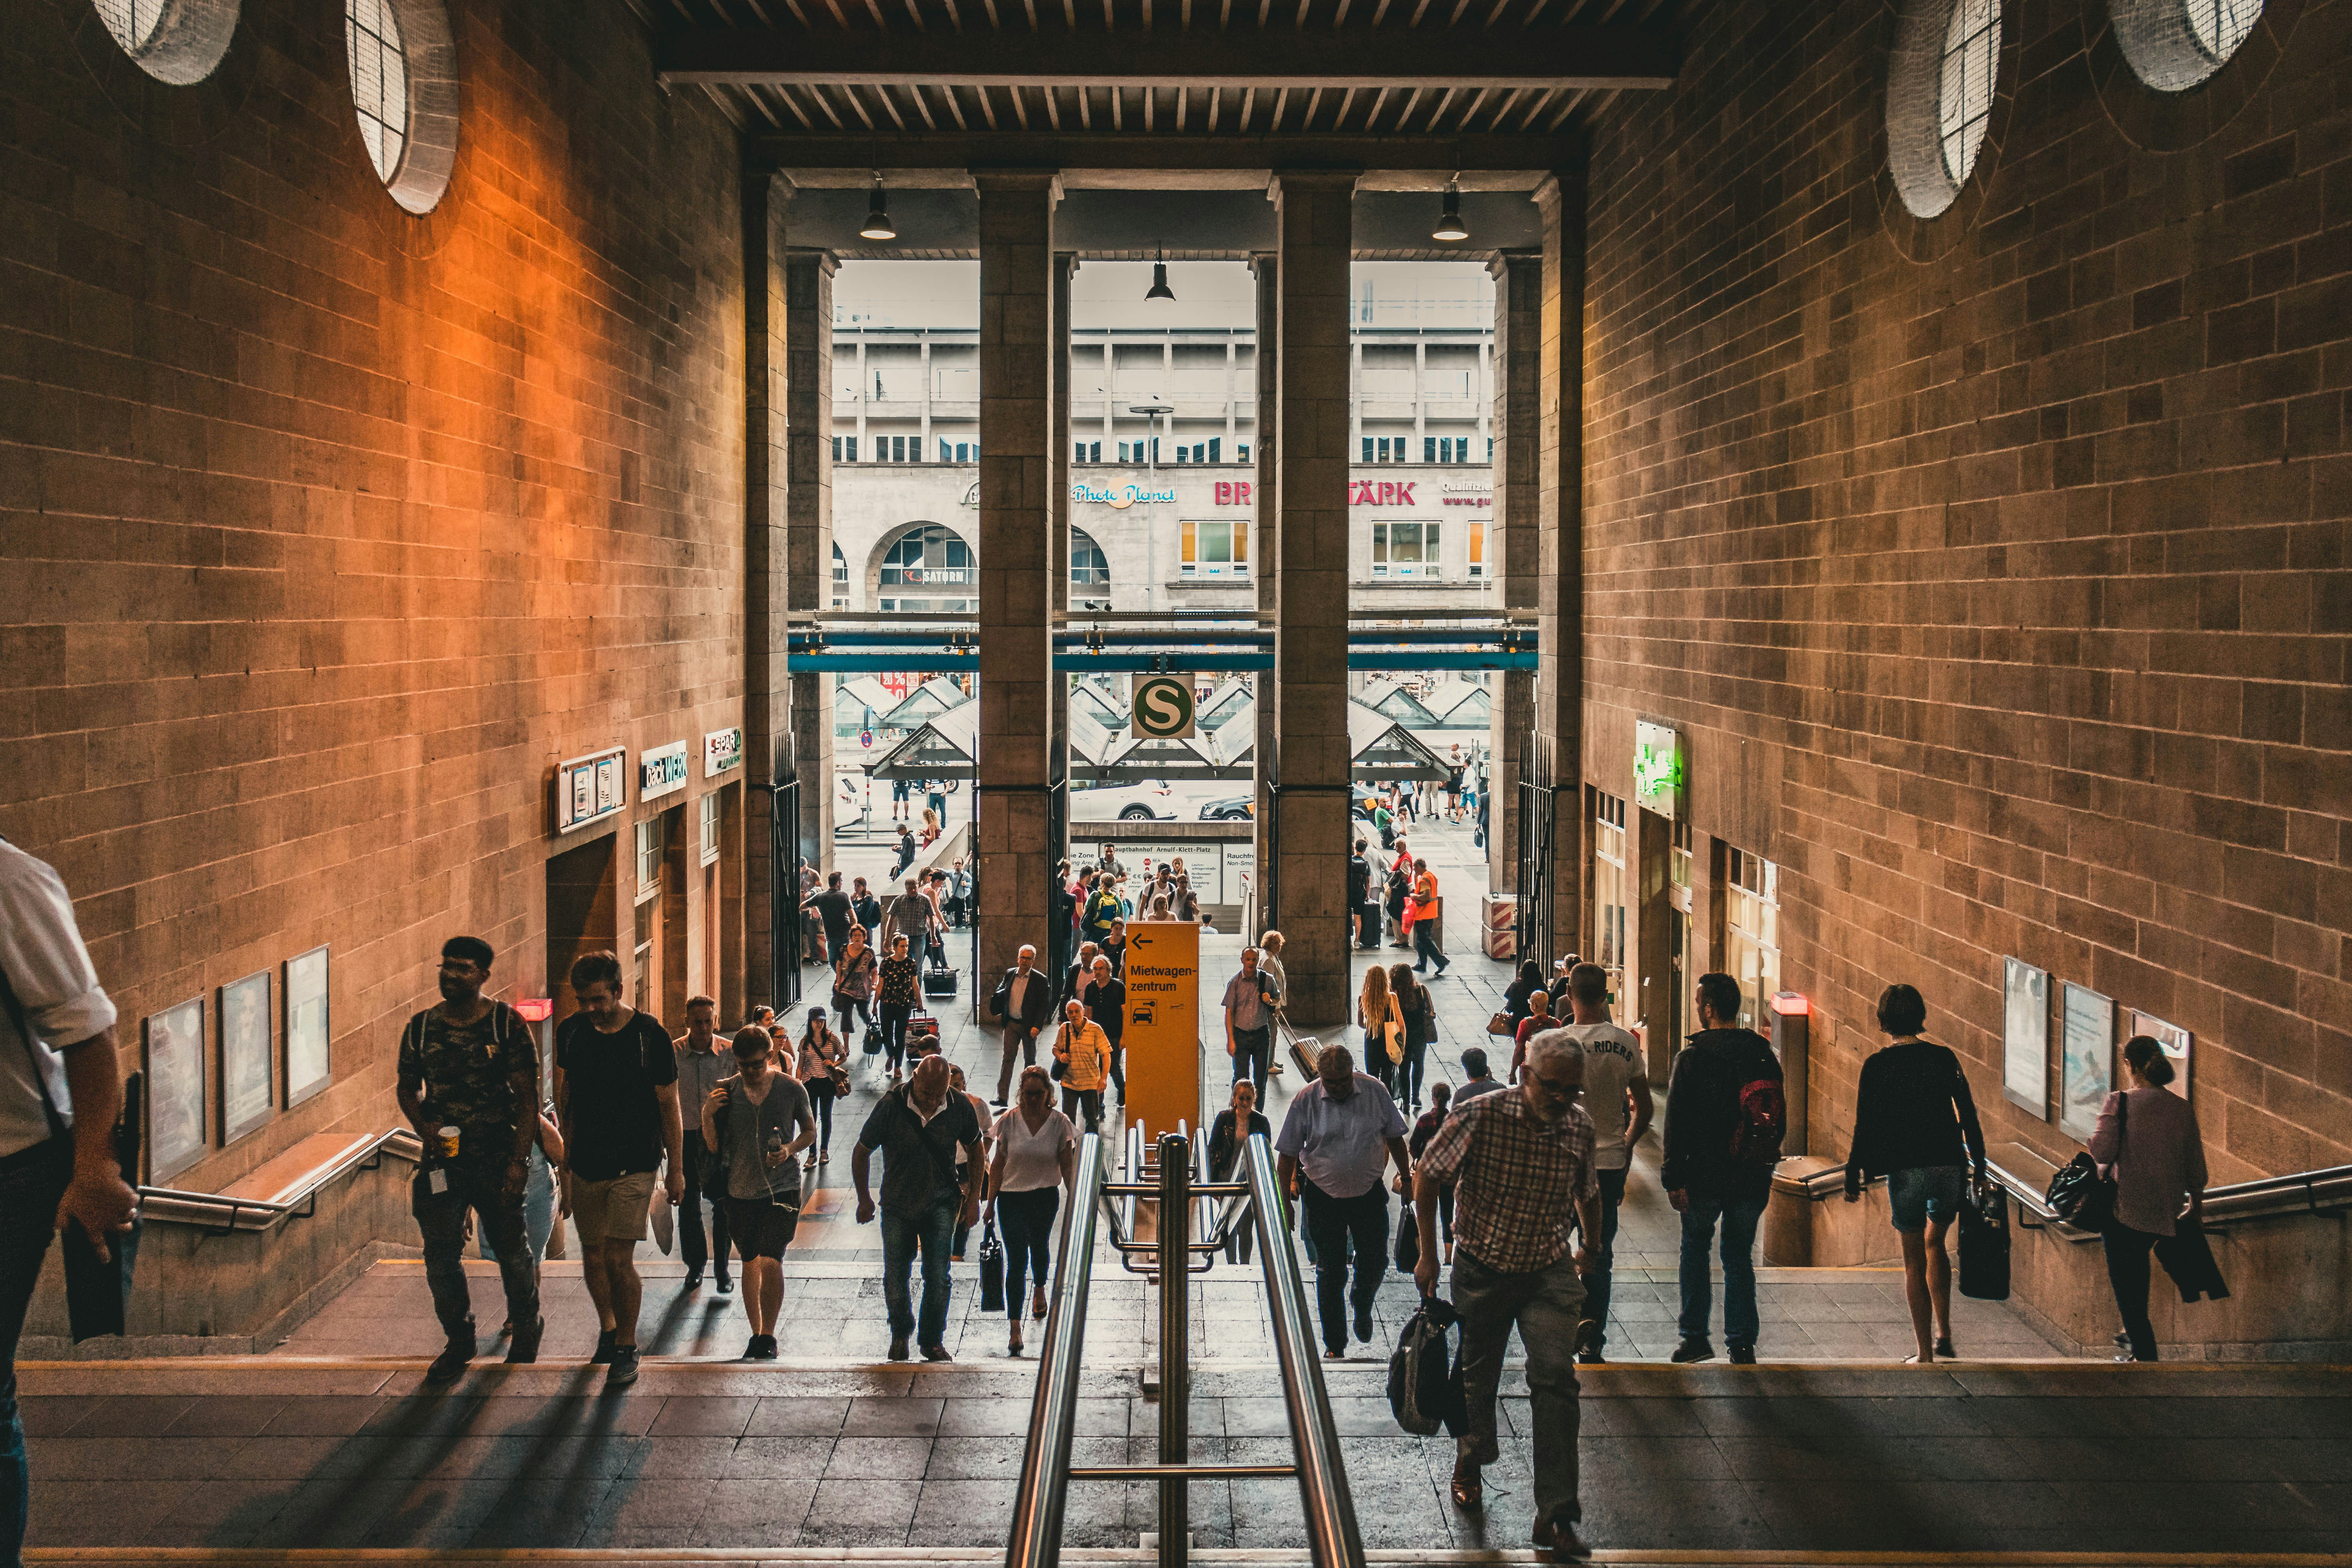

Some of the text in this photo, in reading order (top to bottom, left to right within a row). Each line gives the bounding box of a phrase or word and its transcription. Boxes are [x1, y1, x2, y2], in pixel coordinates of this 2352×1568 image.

[1071, 485, 1175, 501] Photo Planet
[924, 571, 963, 582] SATURN
[1146, 685, 1181, 729] S
[715, 733, 735, 753] SPAR
[646, 751, 687, 787] backWERK
[1131, 966, 1197, 978] Mietwagen-
[1131, 981, 1176, 991] zentrum
[1594, 1040, 1633, 1061] RIDERS
